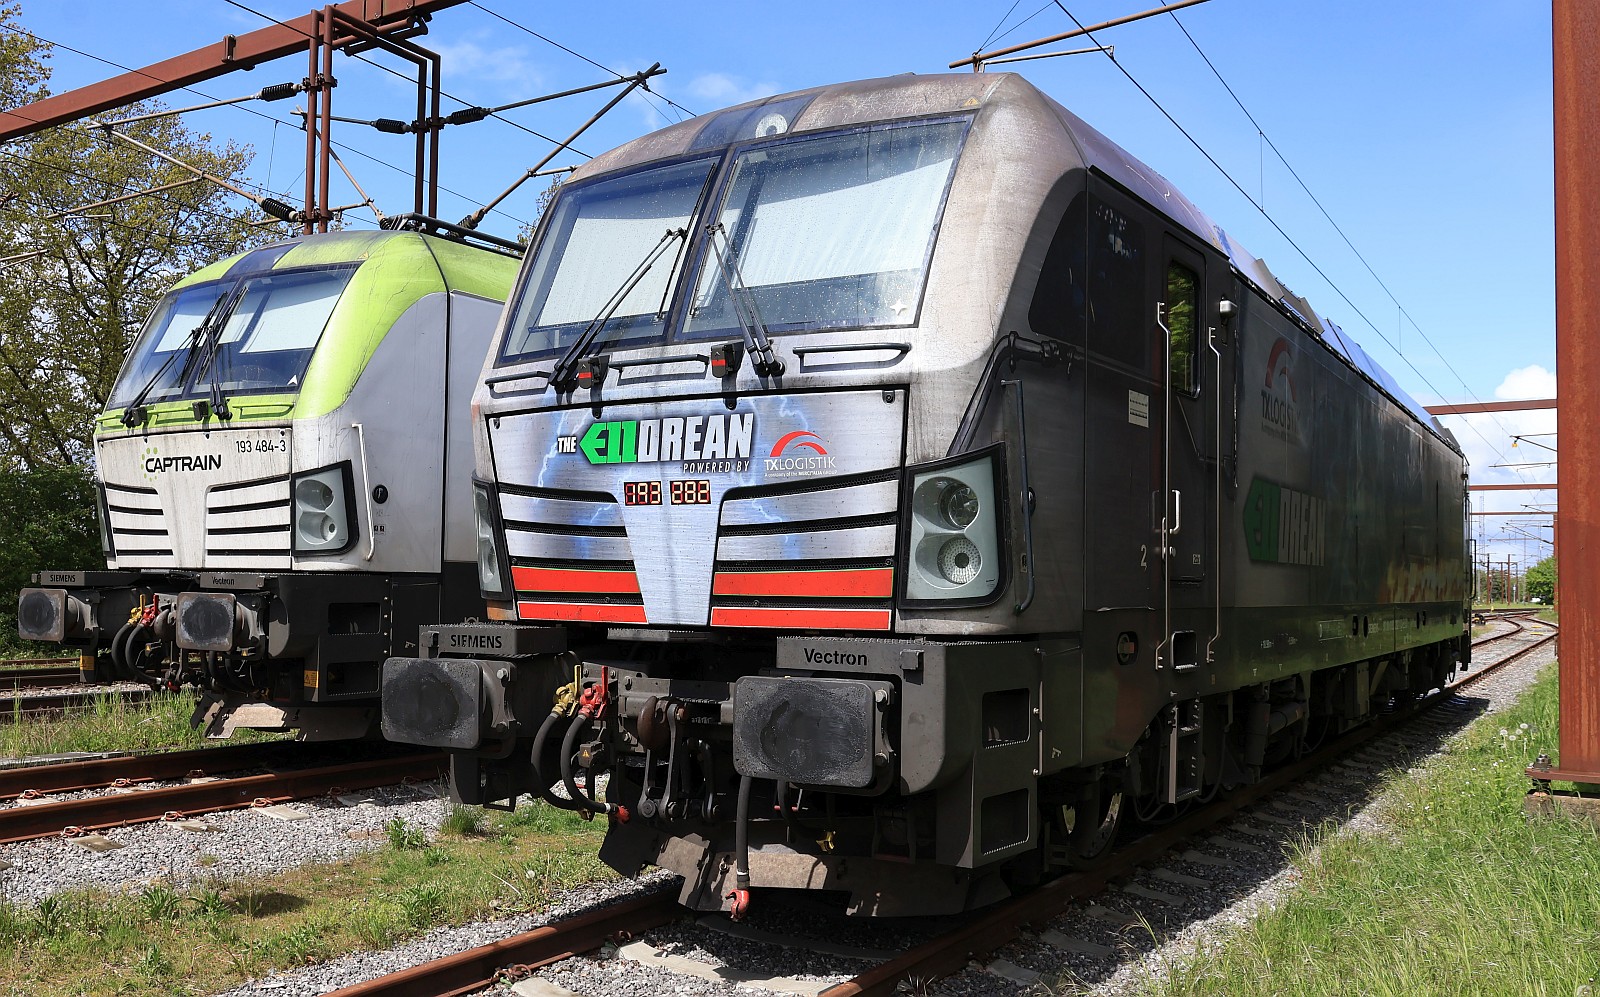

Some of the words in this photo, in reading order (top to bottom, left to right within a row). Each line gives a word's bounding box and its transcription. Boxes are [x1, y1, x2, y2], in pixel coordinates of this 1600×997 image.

[236, 440, 252, 453] 193
[255, 440, 286, 453] 484-3
[557, 436, 577, 453] THE
[145, 454, 222, 473] CAPTRAIN
[683, 461, 731, 474] POWERED
[737, 460, 750, 473] BY
[764, 456, 836, 471] TXLOGISTIK
[1140, 544, 1147, 567] 2
[50, 574, 76, 583] SIEMENS
[212, 576, 235, 586] Vectron
[450, 634, 502, 649] SIEMENS
[803, 647, 868, 666] Vectron
